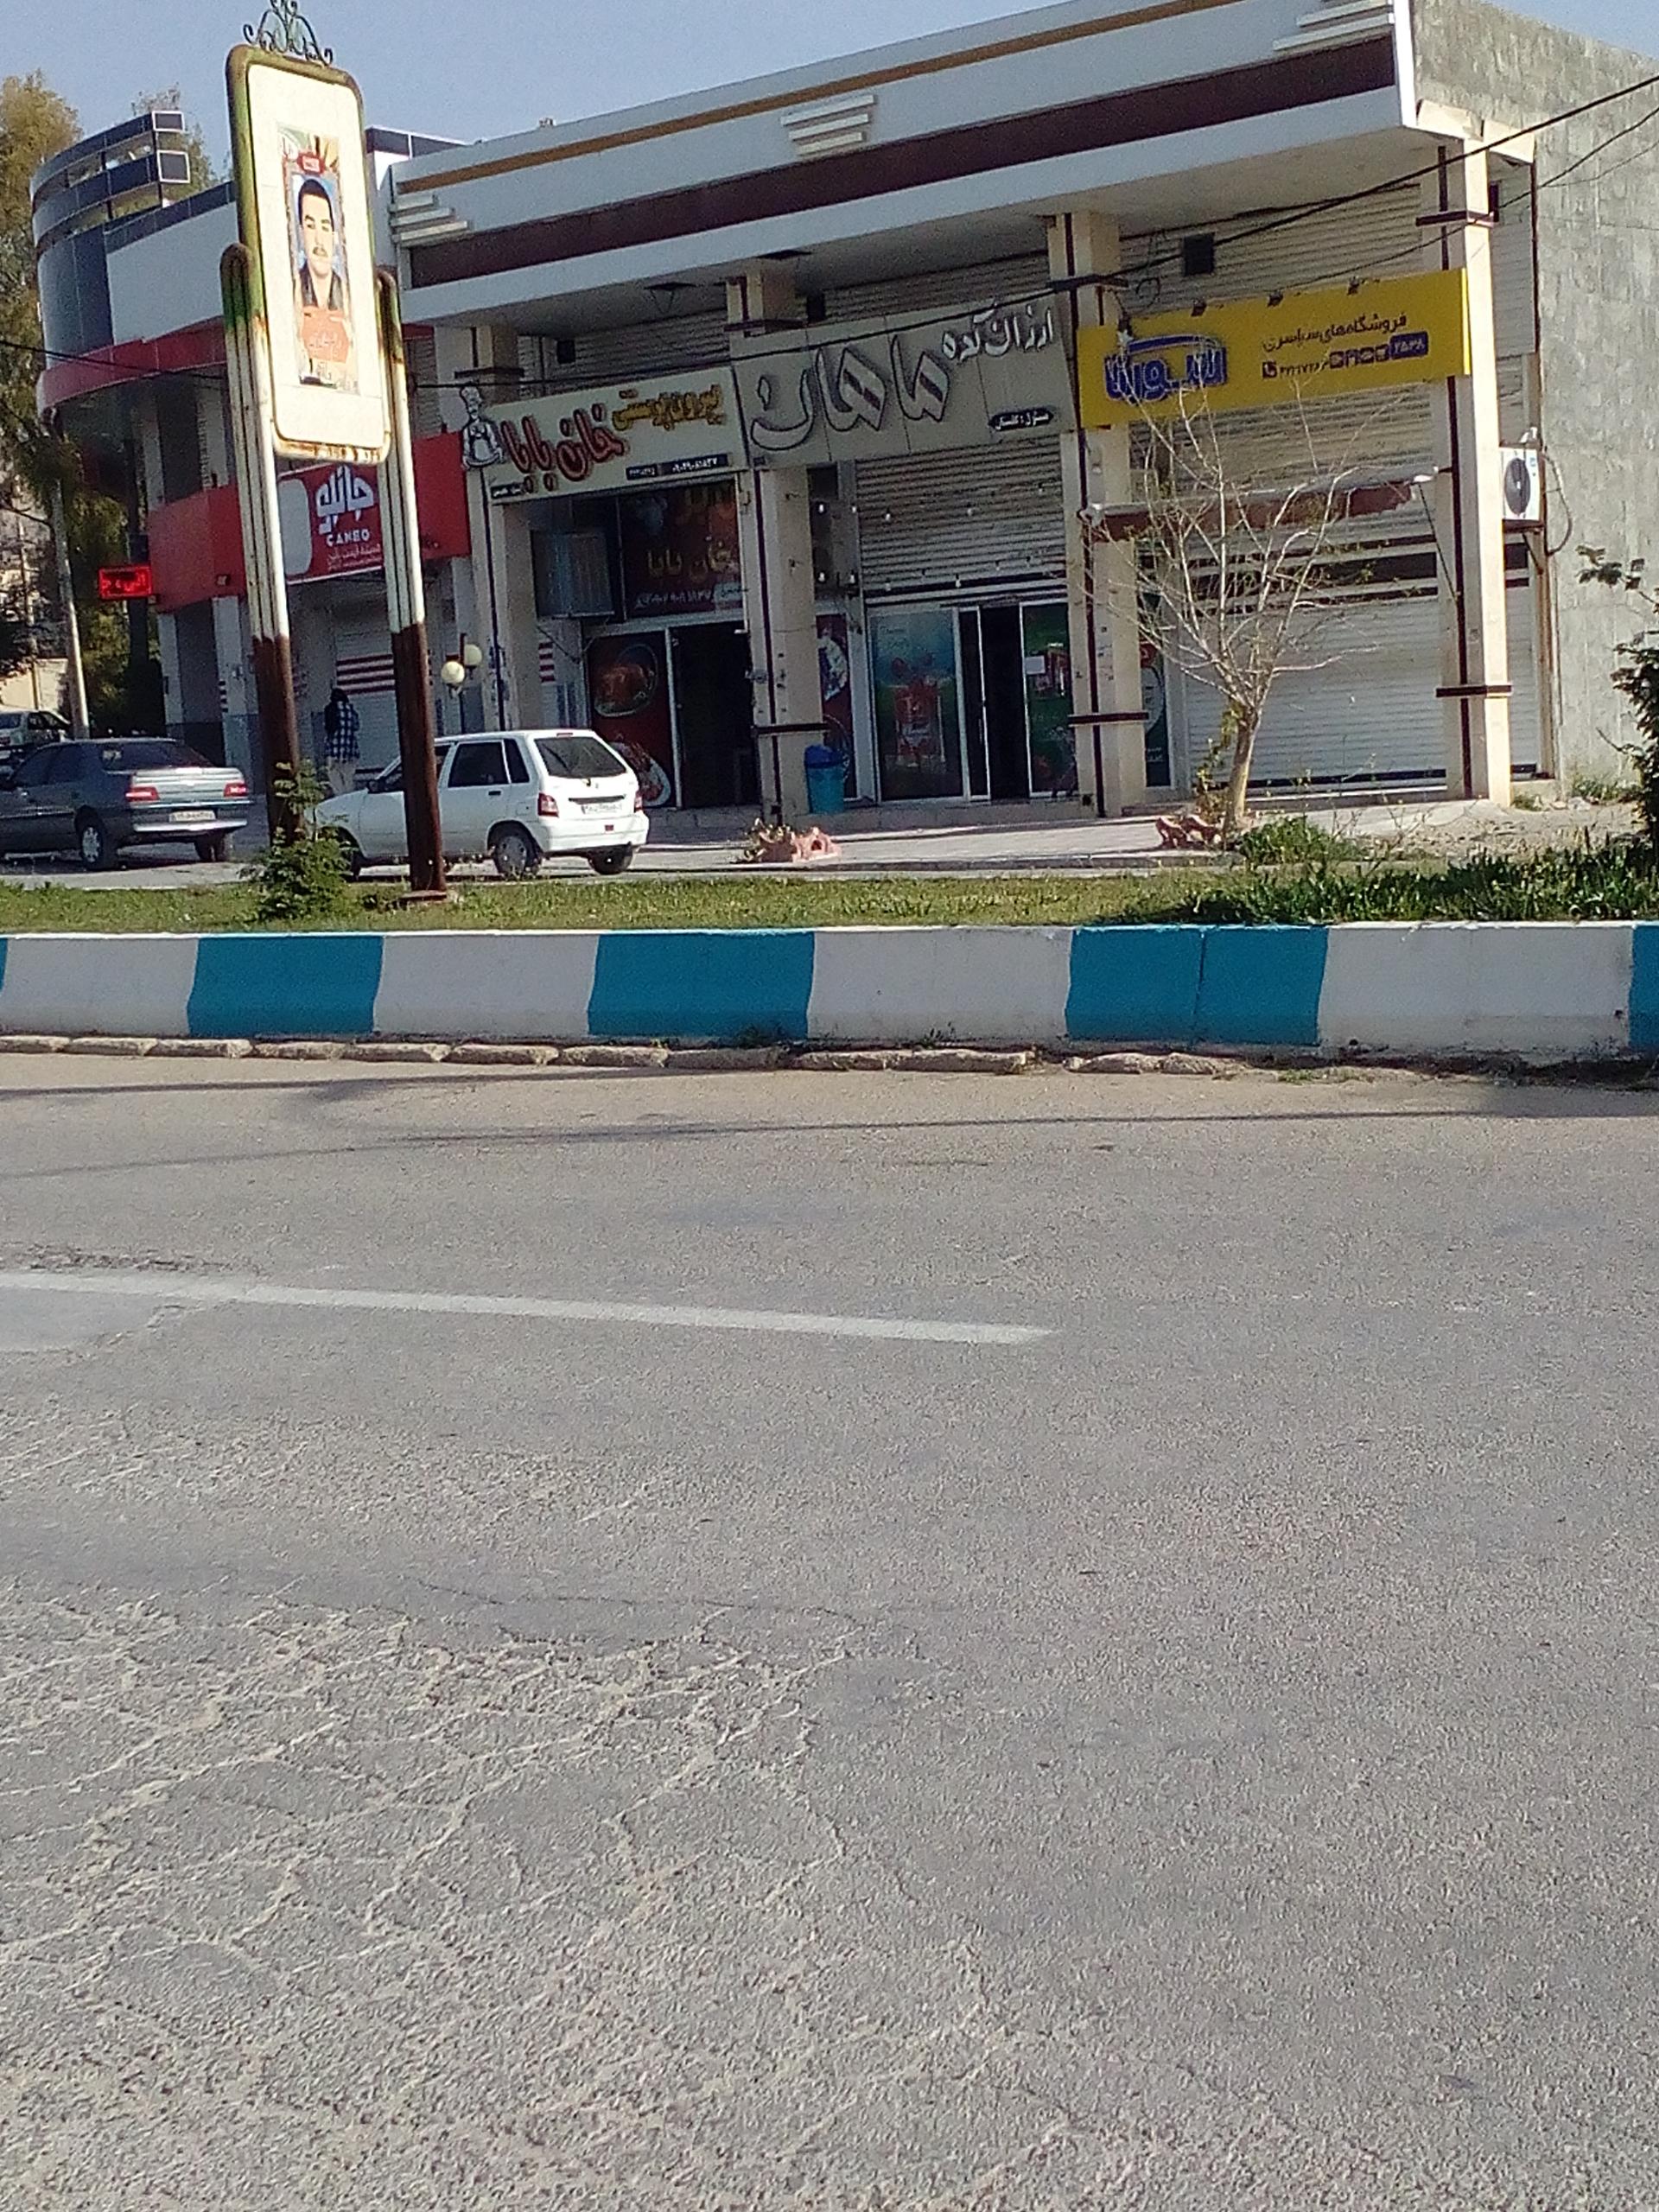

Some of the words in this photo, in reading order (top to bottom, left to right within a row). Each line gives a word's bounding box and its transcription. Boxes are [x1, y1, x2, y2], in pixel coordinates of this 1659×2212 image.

[750, 332, 952, 451] ماهان
[499, 415, 558, 493] بابا
[554, 403, 626, 482] خان
